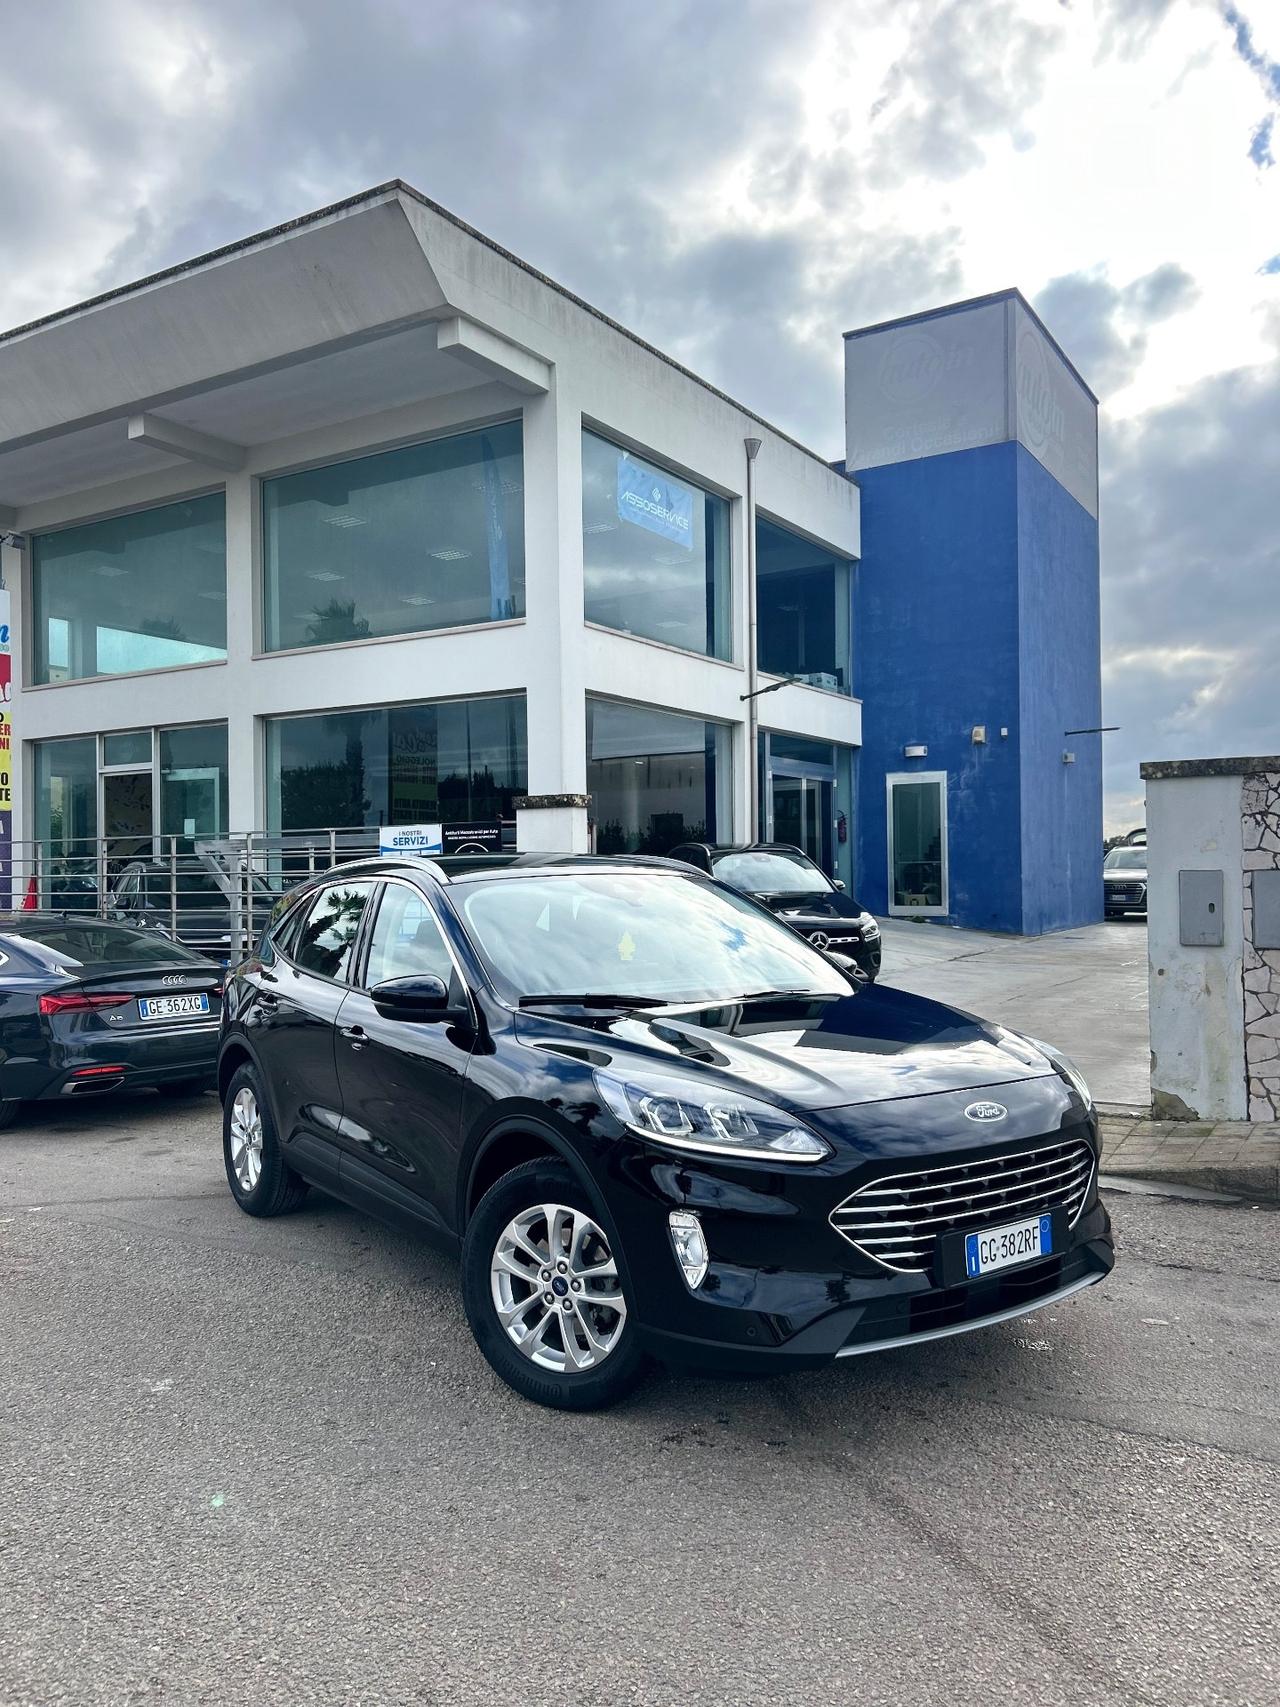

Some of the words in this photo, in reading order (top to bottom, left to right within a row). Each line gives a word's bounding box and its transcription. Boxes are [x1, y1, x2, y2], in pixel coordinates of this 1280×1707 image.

[621, 491, 688, 530] ASSOSERVICE
[393, 836, 428, 846] SERVIZI
[976, 1105, 1000, 1118] Ford
